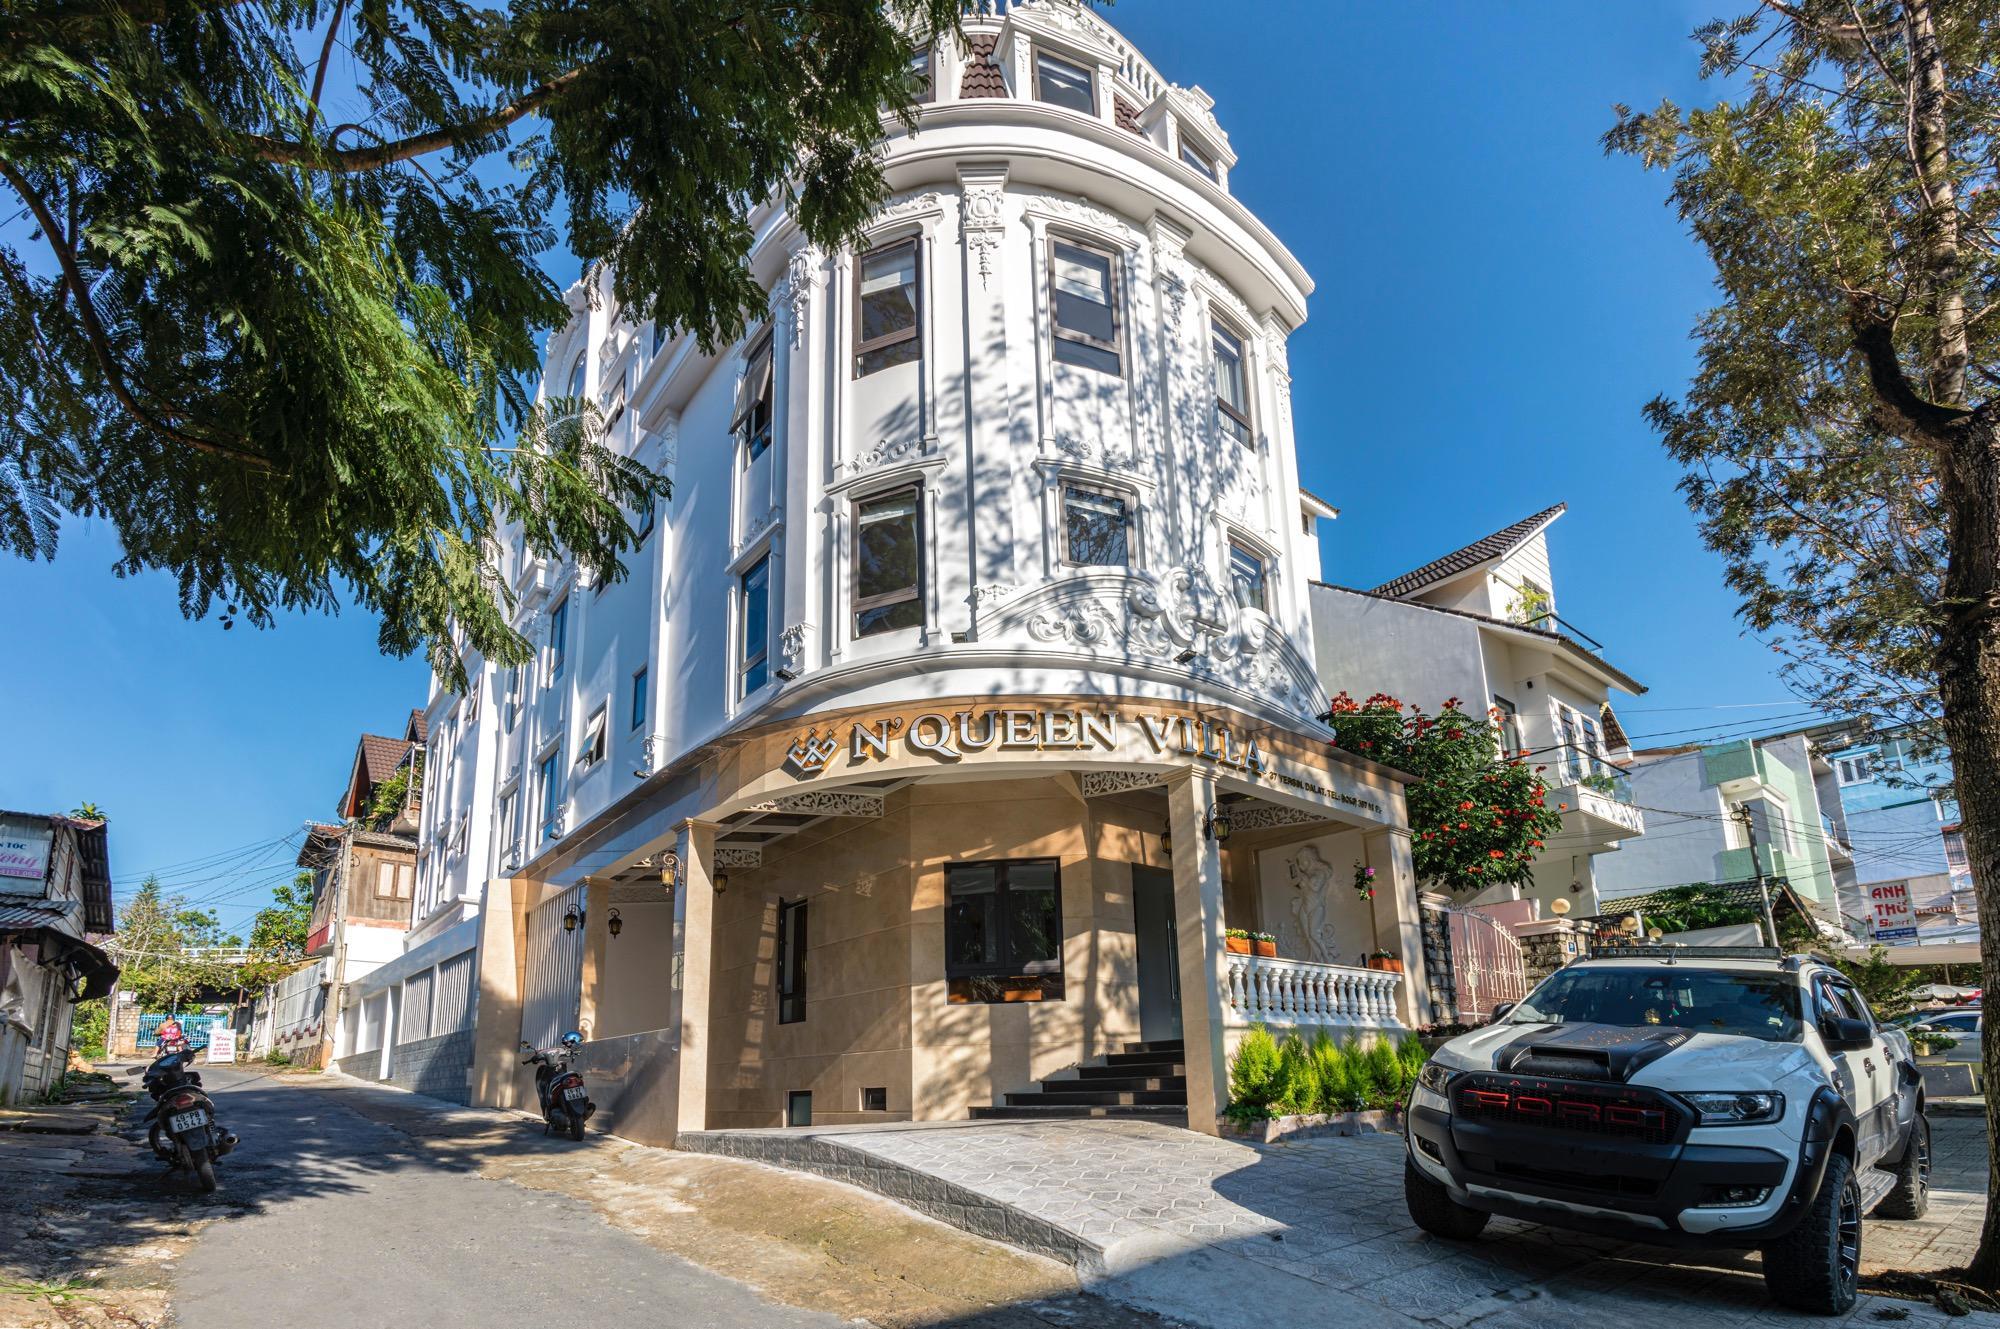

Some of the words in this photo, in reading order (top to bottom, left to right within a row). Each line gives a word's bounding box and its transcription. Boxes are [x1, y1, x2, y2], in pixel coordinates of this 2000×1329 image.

[853, 708, 1119, 759] N'QUEEN
[1137, 713, 1267, 775] VILLA
[1871, 884, 1906, 899] ANH
